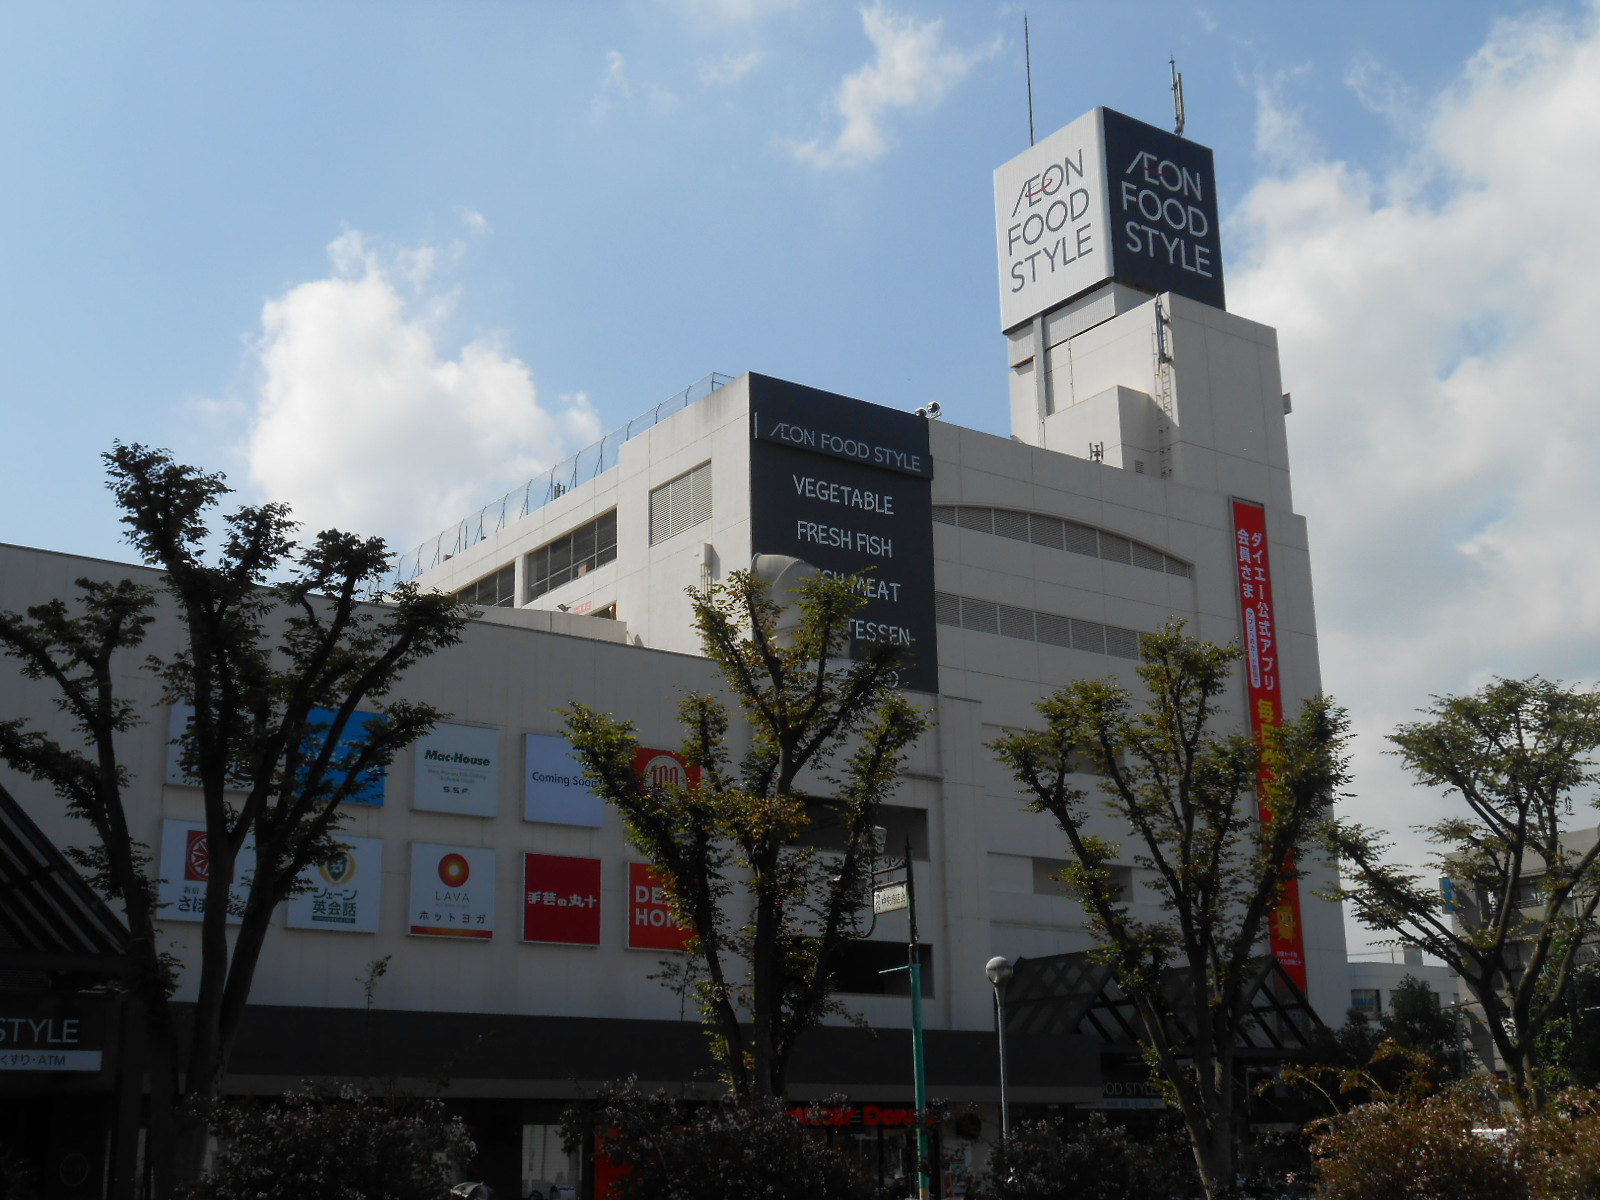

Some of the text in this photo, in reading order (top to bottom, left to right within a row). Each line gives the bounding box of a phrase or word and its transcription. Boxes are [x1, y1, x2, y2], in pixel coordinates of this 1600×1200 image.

[1008, 188, 1089, 256] FOOD
[1121, 180, 1208, 238] FOOD
[1011, 223, 1093, 293] STYLE
[1126, 221, 1213, 278] STYLE
[821, 433, 869, 459] FOOD
[874, 446, 921, 472] STYLE
[793, 474, 894, 515] VEGETABLE
[797, 520, 892, 558] FRESH FISH
[1237, 528, 1254, 598] 会員さま
[1251, 532, 1274, 691] ダイエー公式アプリ
[848, 618, 910, 647] TESSEN
[532, 771, 570, 787] Coming
[312, 900, 356, 917] 英会話
[435, 891, 470, 903] LAVA
[528, 891, 597, 908] 手芸の丸十
[419, 911, 486, 924] ホットヨガ
[1103, 1082, 1123, 1096] OD
